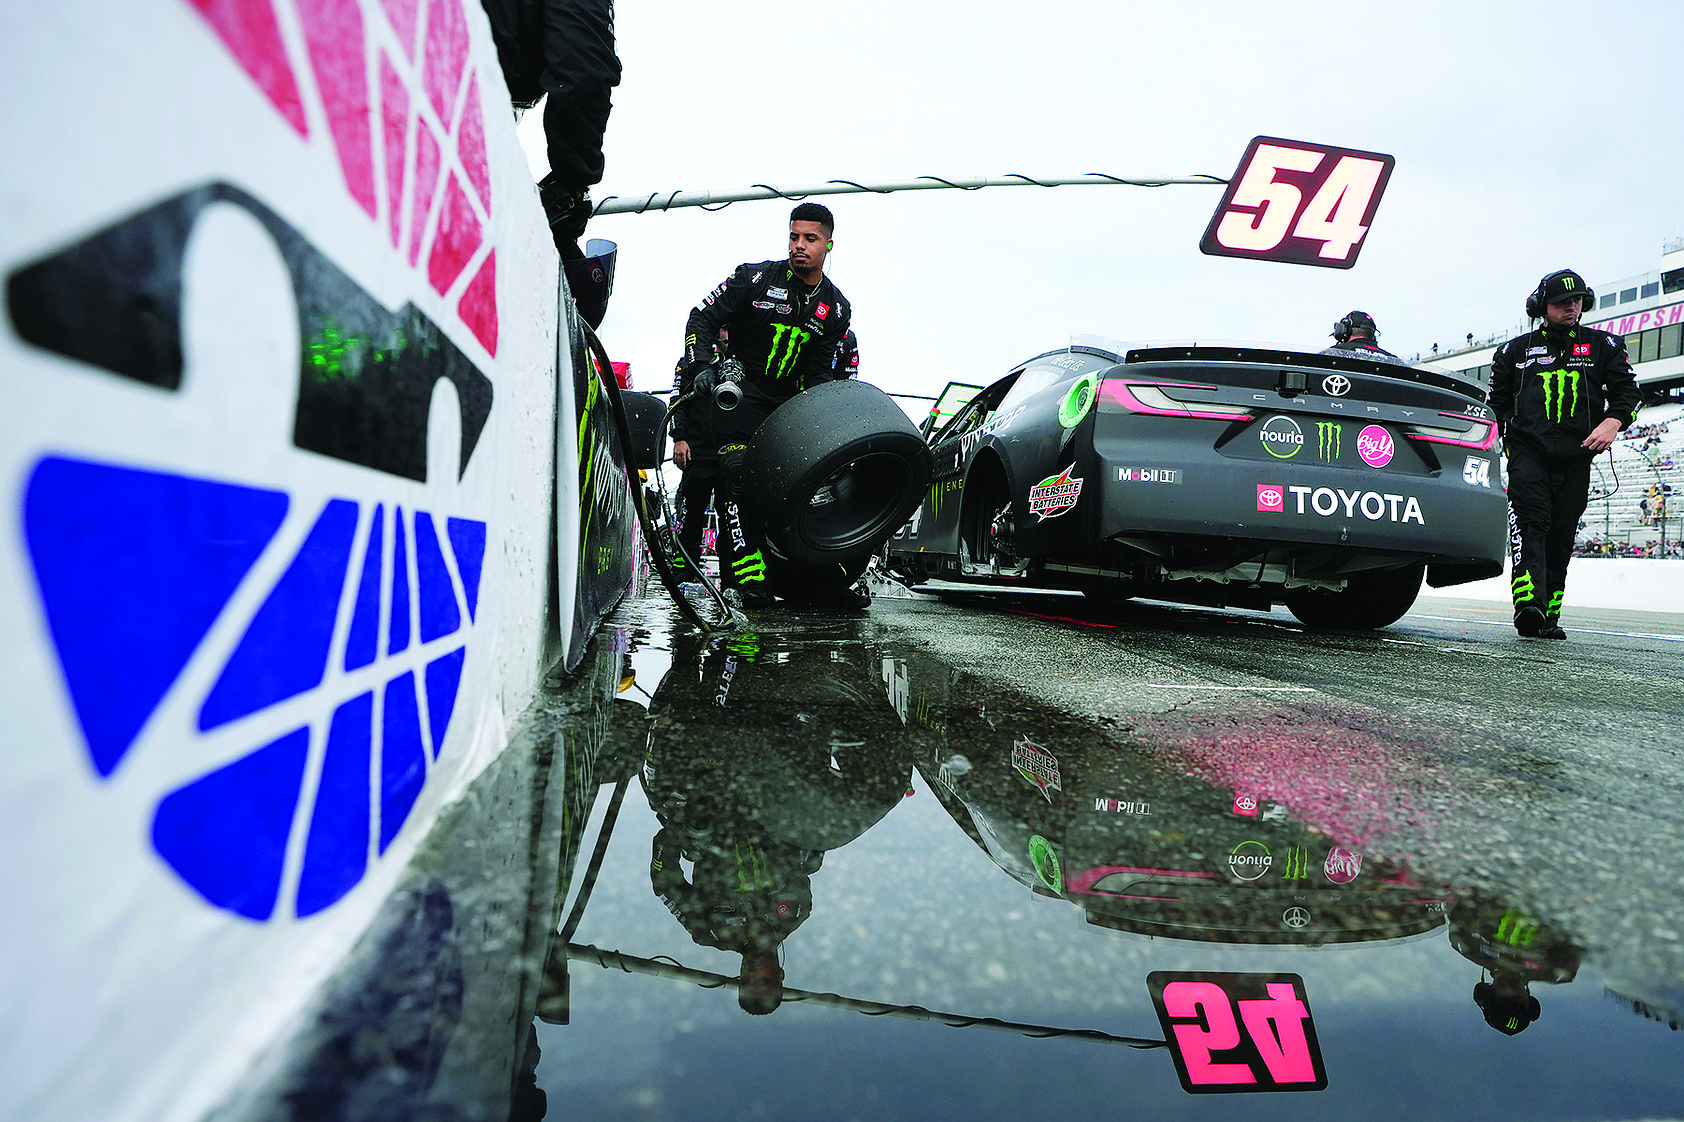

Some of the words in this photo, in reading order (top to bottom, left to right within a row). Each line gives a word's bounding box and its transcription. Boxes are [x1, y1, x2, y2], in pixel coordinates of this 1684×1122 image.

[1216, 143, 1369, 260] 54
[1252, 394, 1414, 417] CAMRY
[1462, 404, 1488, 419] XSE
[1259, 430, 1304, 445] nouria
[1118, 468, 1158, 482] Mobil
[1462, 455, 1491, 489] 54
[1031, 482, 1080, 499] INTERSTATE
[1033, 494, 1076, 510] BATTERIES
[1288, 485, 1426, 526] TOYOTA
